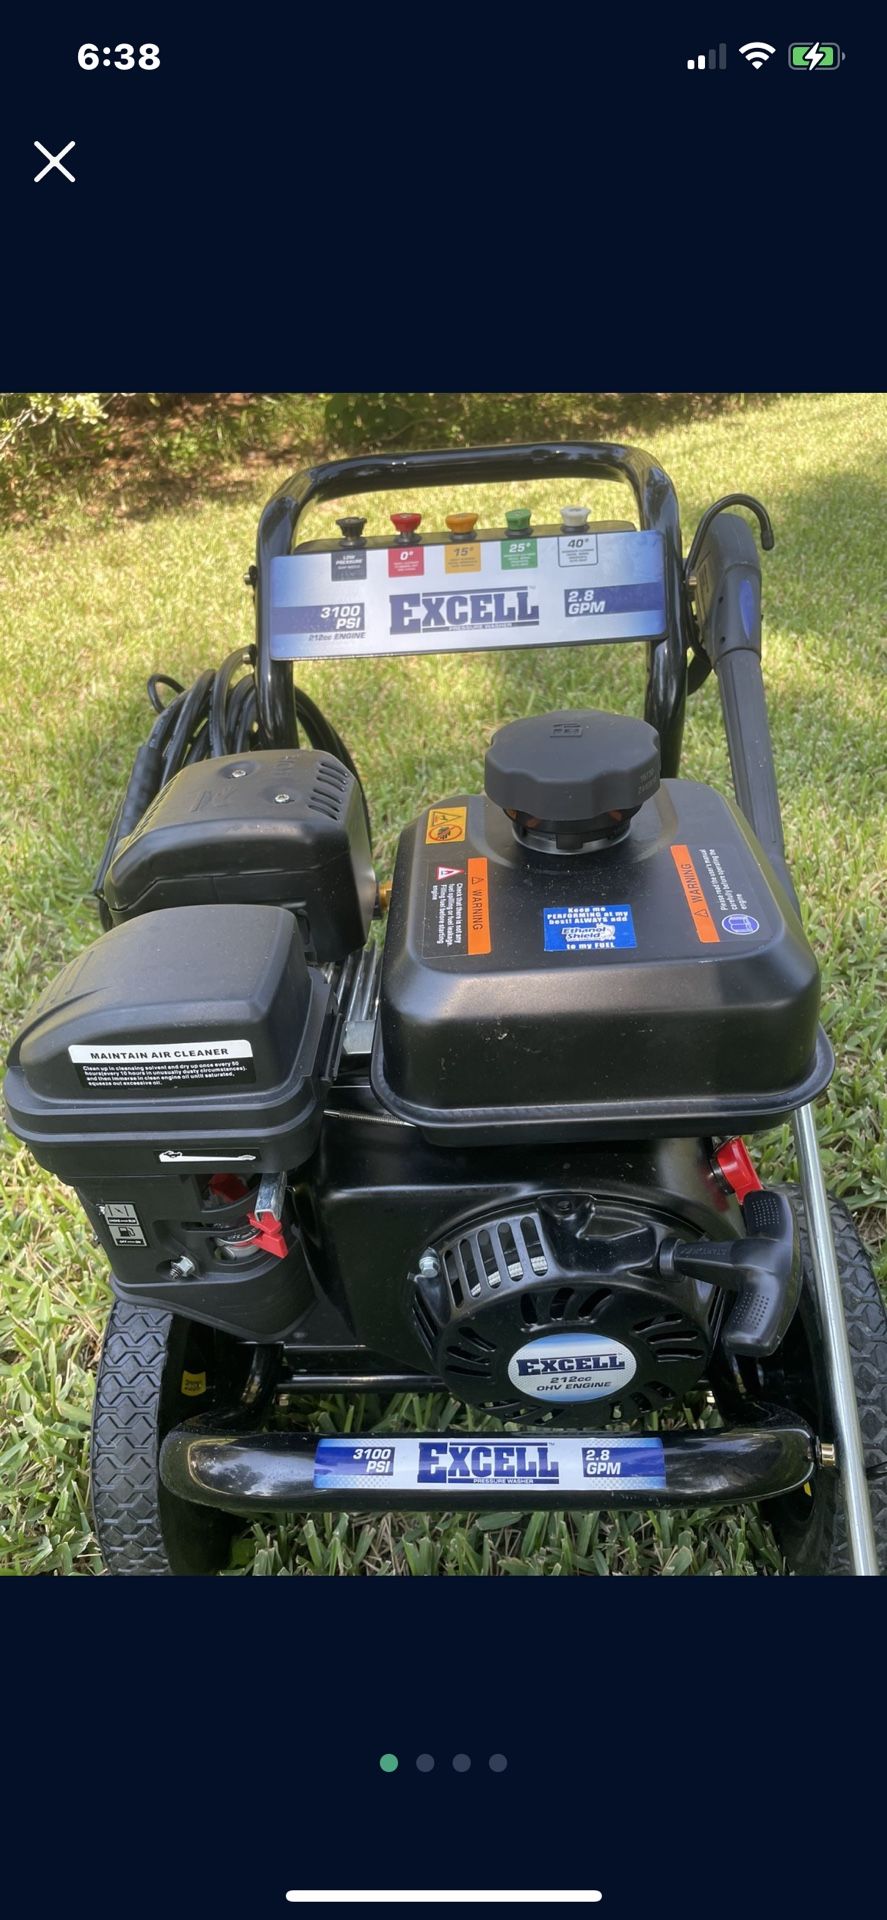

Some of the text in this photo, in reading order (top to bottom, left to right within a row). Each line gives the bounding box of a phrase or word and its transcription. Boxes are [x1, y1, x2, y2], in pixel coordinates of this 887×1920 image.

[508, 542, 532, 553] 25°
[568, 590, 594, 602] 2.8
[320, 605, 361, 618] 3100
[389, 586, 540, 635] EXCELL
[568, 601, 606, 614] GPM
[335, 617, 360, 630] PSI
[333, 631, 366, 640] ENGINE
[680, 863, 704, 904] WARNING
[472, 889, 484, 930] WARNING
[174, 1049, 229, 1057] CLEANER
[516, 1354, 626, 1377] EXCELL
[536, 1381, 612, 1392] OHV ENGINE
[550, 1376, 592, 1384] 212cc
[352, 1448, 392, 1460] 3100
[585, 1449, 610, 1461] 2.8
[366, 1460, 390, 1473] PSI
[417, 1442, 560, 1484] EXCELL
[586, 1462, 622, 1475] GPM
